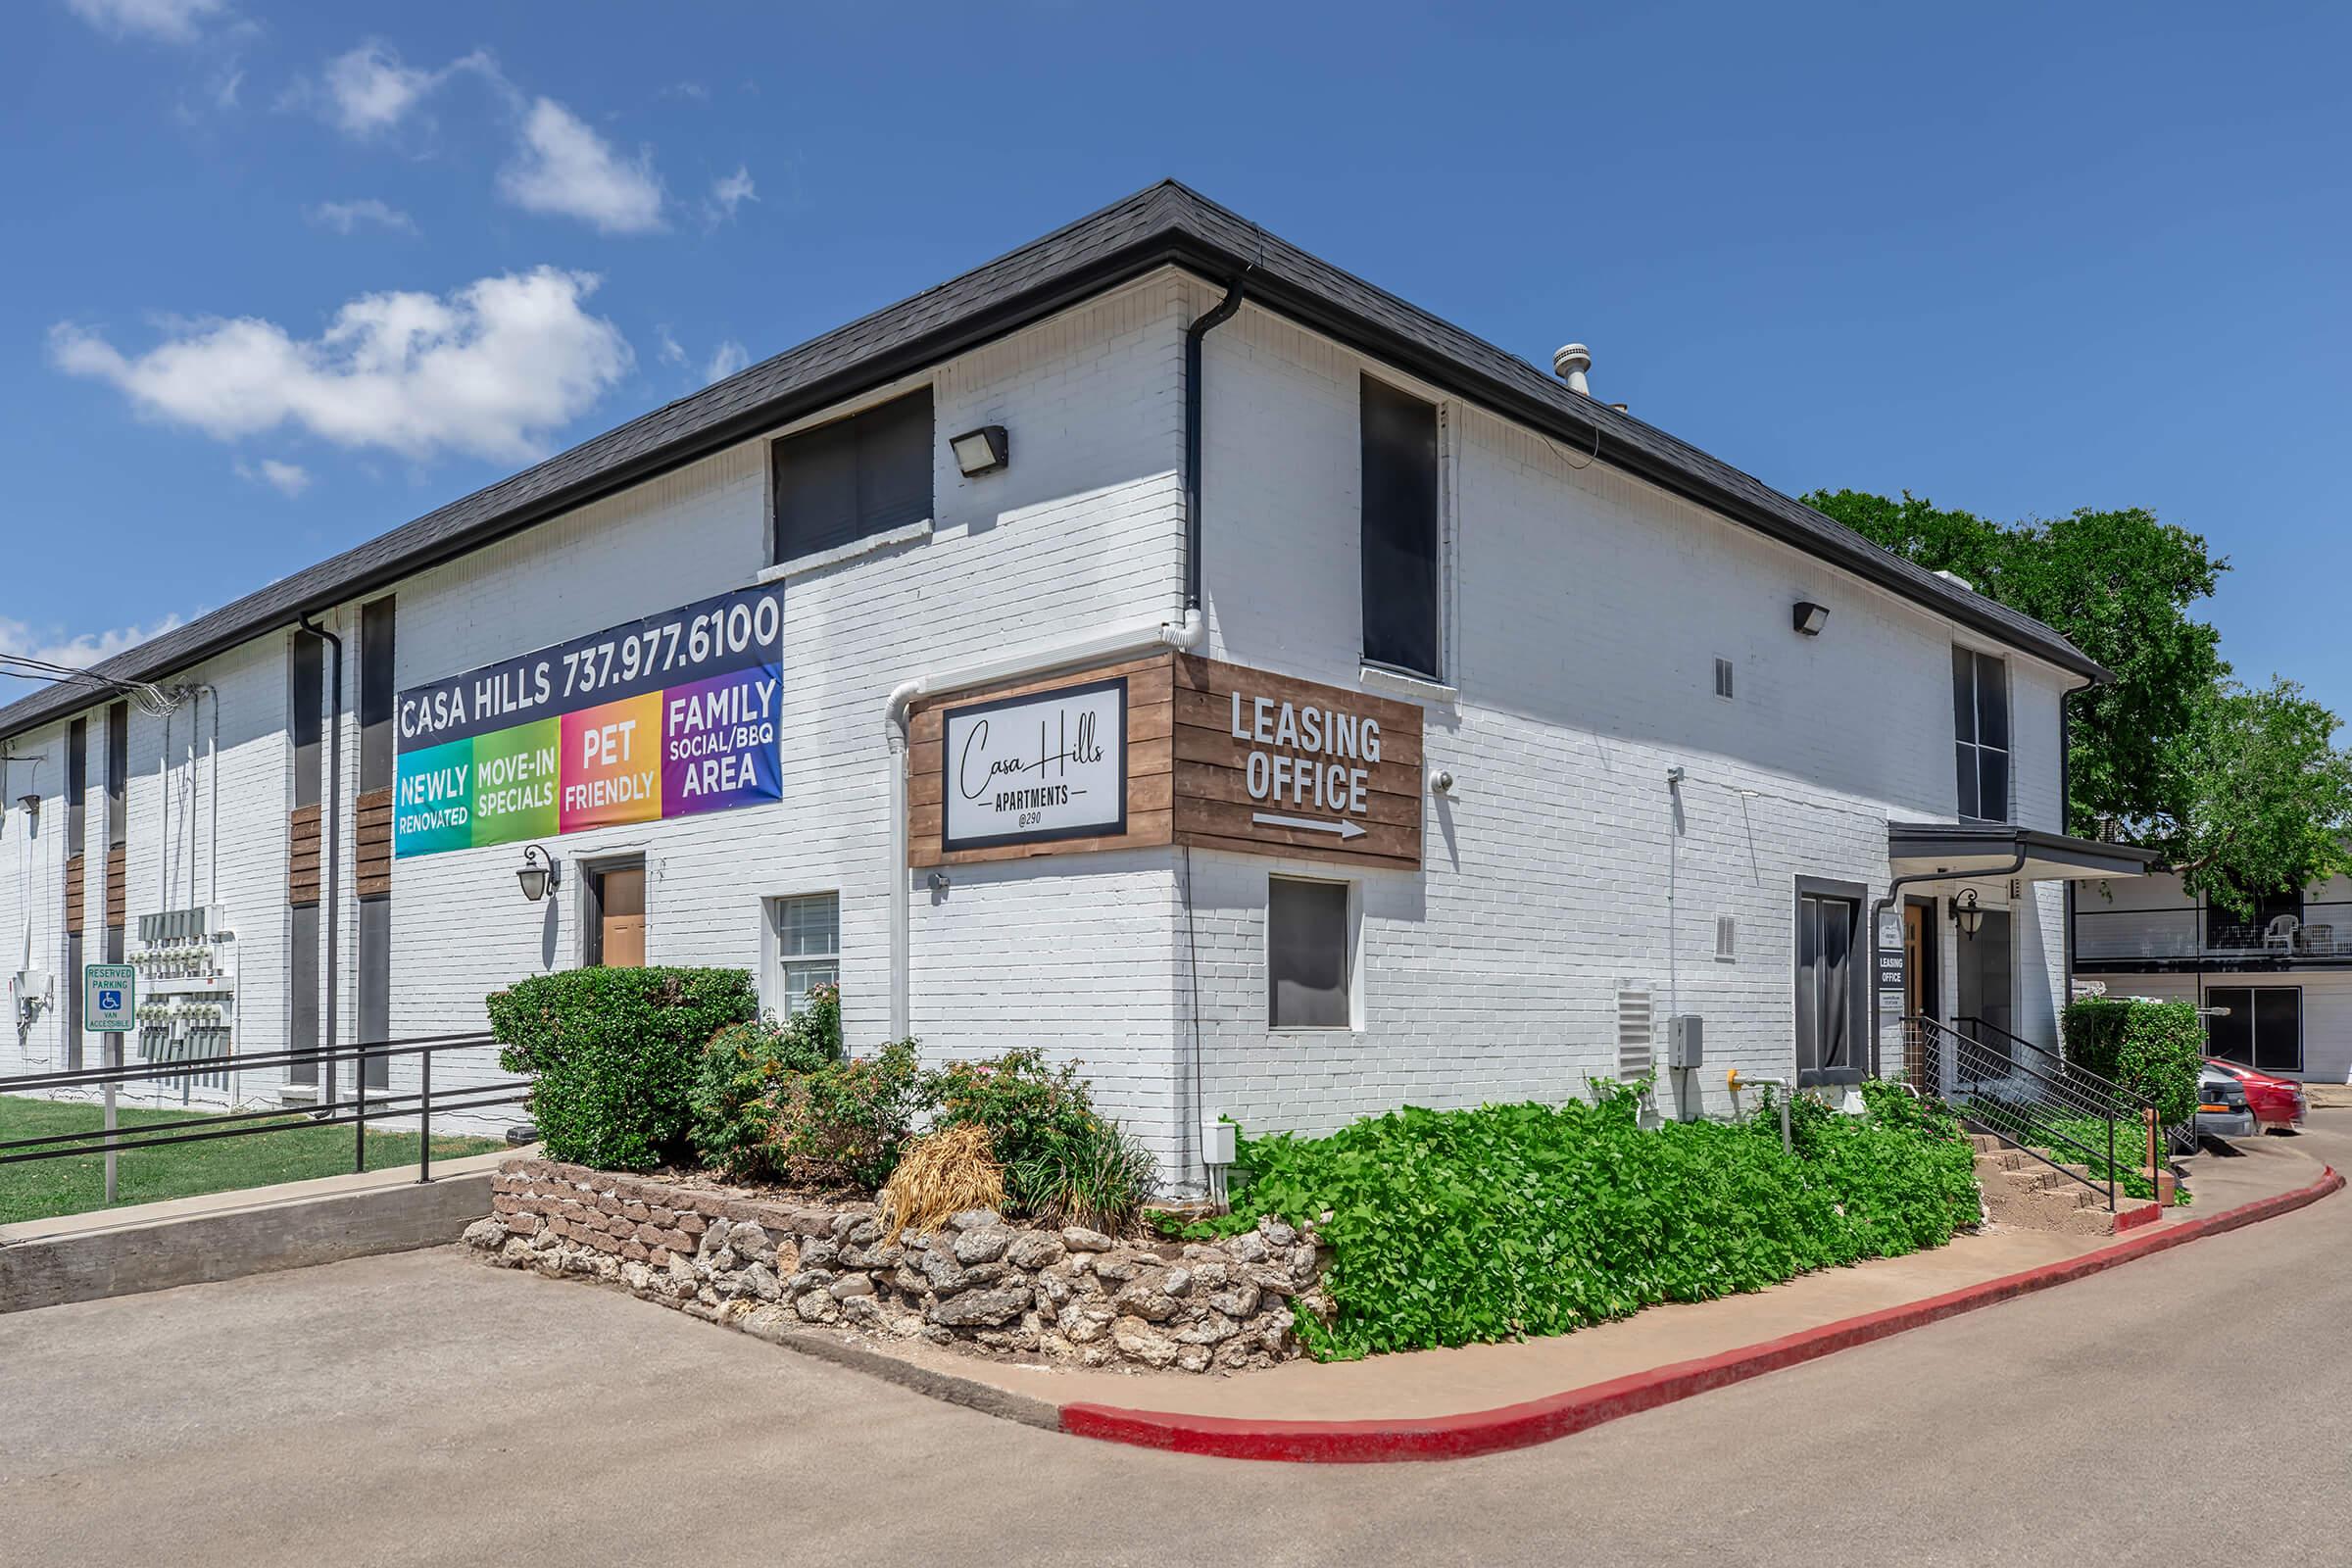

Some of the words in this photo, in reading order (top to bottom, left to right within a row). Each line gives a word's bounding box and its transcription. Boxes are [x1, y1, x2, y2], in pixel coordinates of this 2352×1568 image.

[401, 686, 466, 738] CASA
[475, 662, 550, 720] HILLS
[564, 596, 779, 698] 737.977.6100
[669, 678, 776, 737] FAMILY
[1231, 691, 1381, 763] LEASING
[583, 719, 635, 769] PET
[670, 722, 773, 761] SOCIAL/BBQ
[960, 719, 1025, 799] Casa
[1023, 710, 1103, 779] Hills
[401, 764, 468, 807] NEWLY
[478, 747, 555, 788] MOVE-IN
[682, 753, 758, 798] AREA
[1246, 751, 1367, 812] OFFICE
[478, 782, 554, 817] SPECIALS
[565, 771, 654, 811] FRIENDLY
[995, 786, 1068, 812] APARTMENTS
[399, 807, 467, 835] RENOVATED
[1018, 811, 1042, 828] @290
[88, 969, 131, 978] RESERVED
[1880, 957, 1902, 967] LEASING
[1883, 972, 1901, 982] OFFICE
